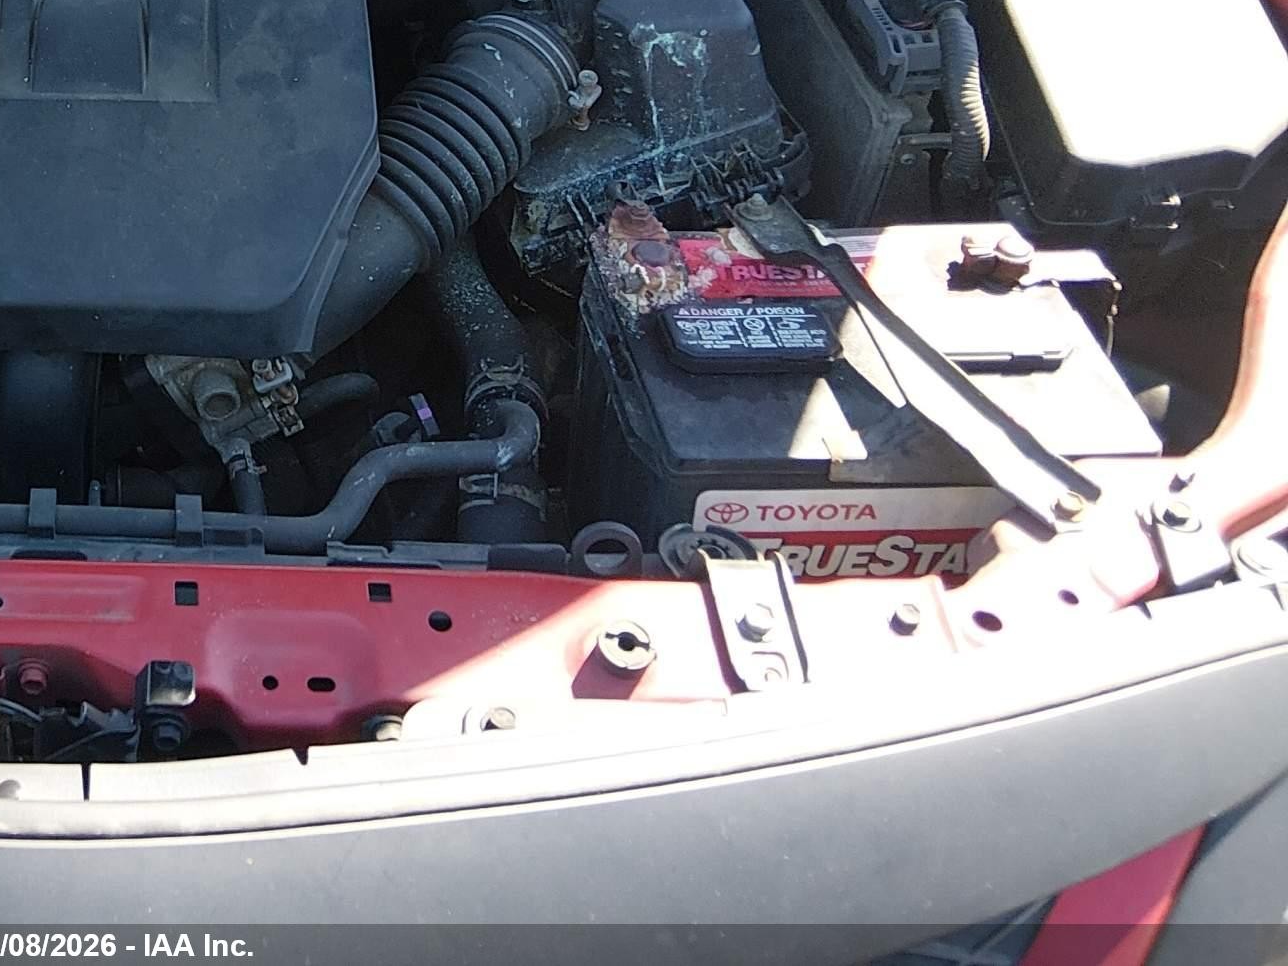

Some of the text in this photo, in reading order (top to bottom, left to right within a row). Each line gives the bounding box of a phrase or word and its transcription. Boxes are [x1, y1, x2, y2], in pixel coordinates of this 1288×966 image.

[690, 307, 745, 316] DANGER
[755, 306, 806, 315] POISON
[755, 503, 878, 522] TOYOTA
[749, 535, 974, 577] TRUESTA
